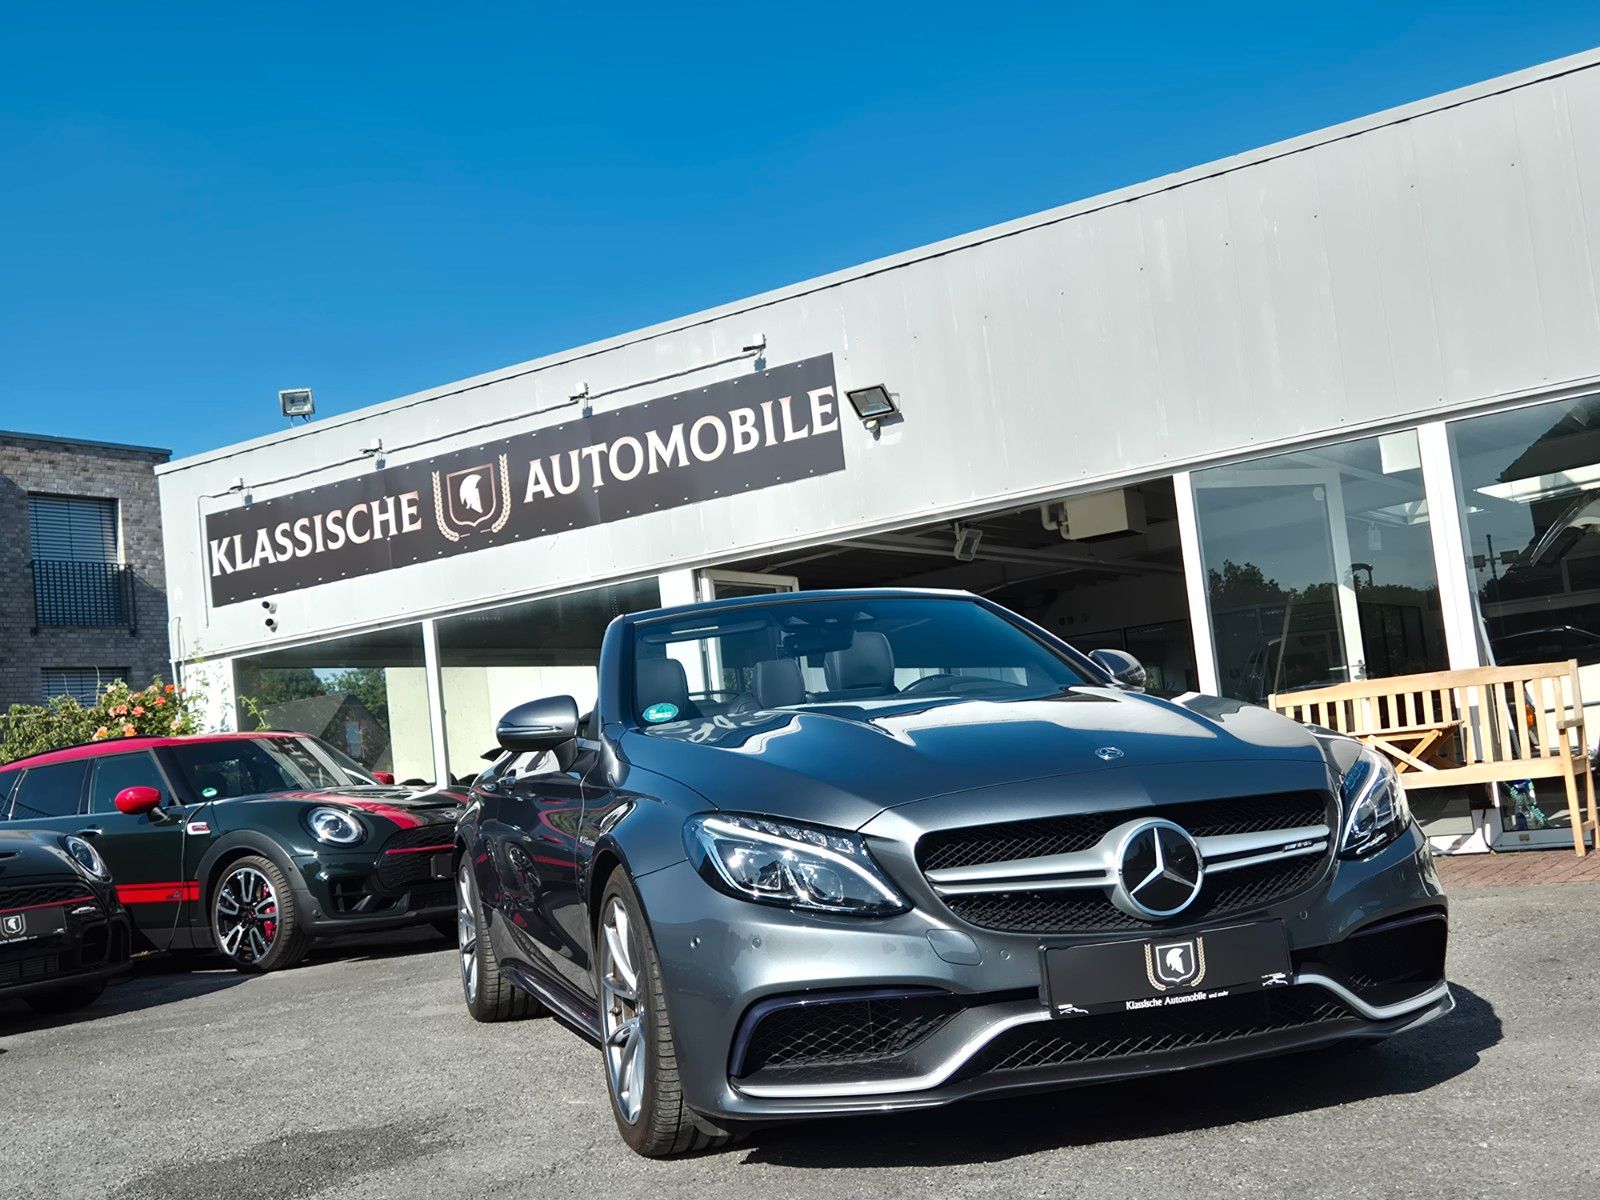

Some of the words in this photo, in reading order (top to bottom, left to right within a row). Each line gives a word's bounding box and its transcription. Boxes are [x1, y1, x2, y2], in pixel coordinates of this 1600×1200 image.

[209, 491, 422, 577] KLASSISCHE
[524, 386, 839, 504] AUTOMOBILE
[1126, 999, 1162, 1010] Klassische
[1164, 992, 1206, 1005] Automobile
